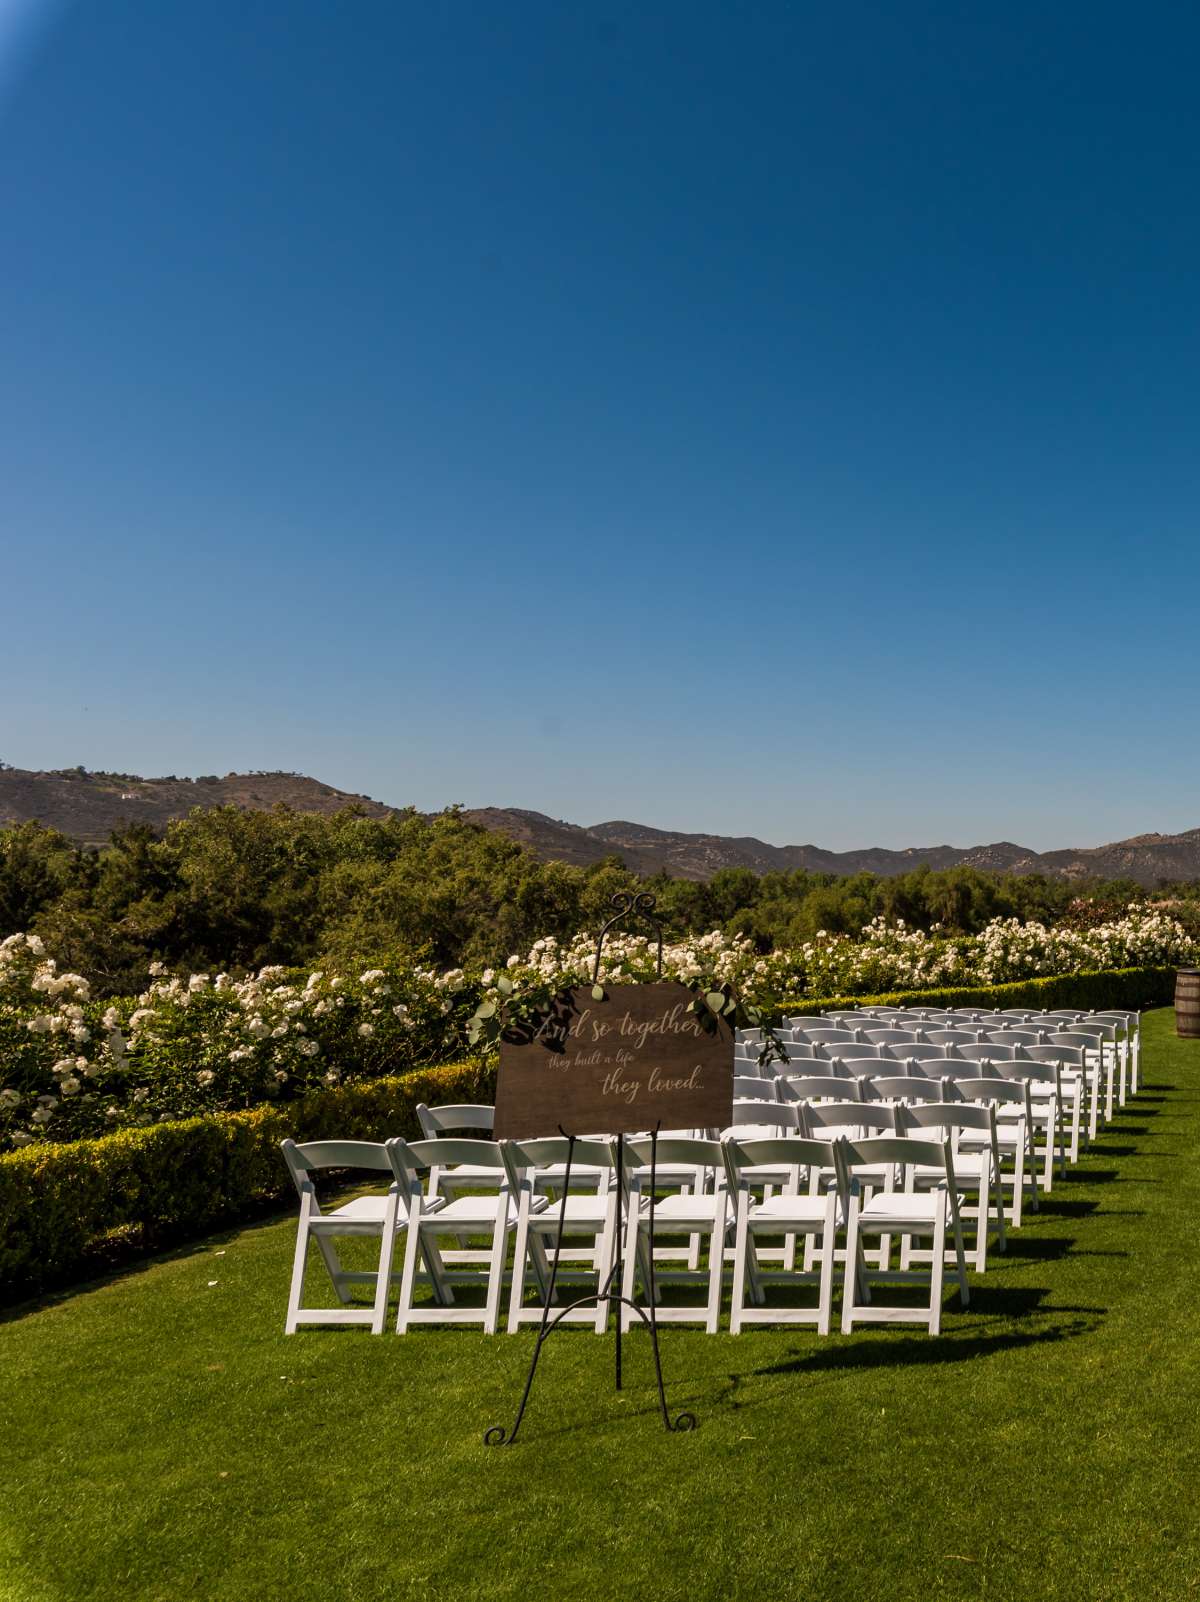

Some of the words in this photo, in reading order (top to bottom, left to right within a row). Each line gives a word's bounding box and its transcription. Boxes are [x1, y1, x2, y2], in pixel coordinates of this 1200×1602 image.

[533, 1009, 591, 1041] And
[592, 1020, 613, 1041] so
[616, 1003, 703, 1048] together
[548, 1052, 571, 1072] they
[574, 1049, 601, 1066] built
[615, 1048, 635, 1067] life
[598, 1067, 641, 1104] they
